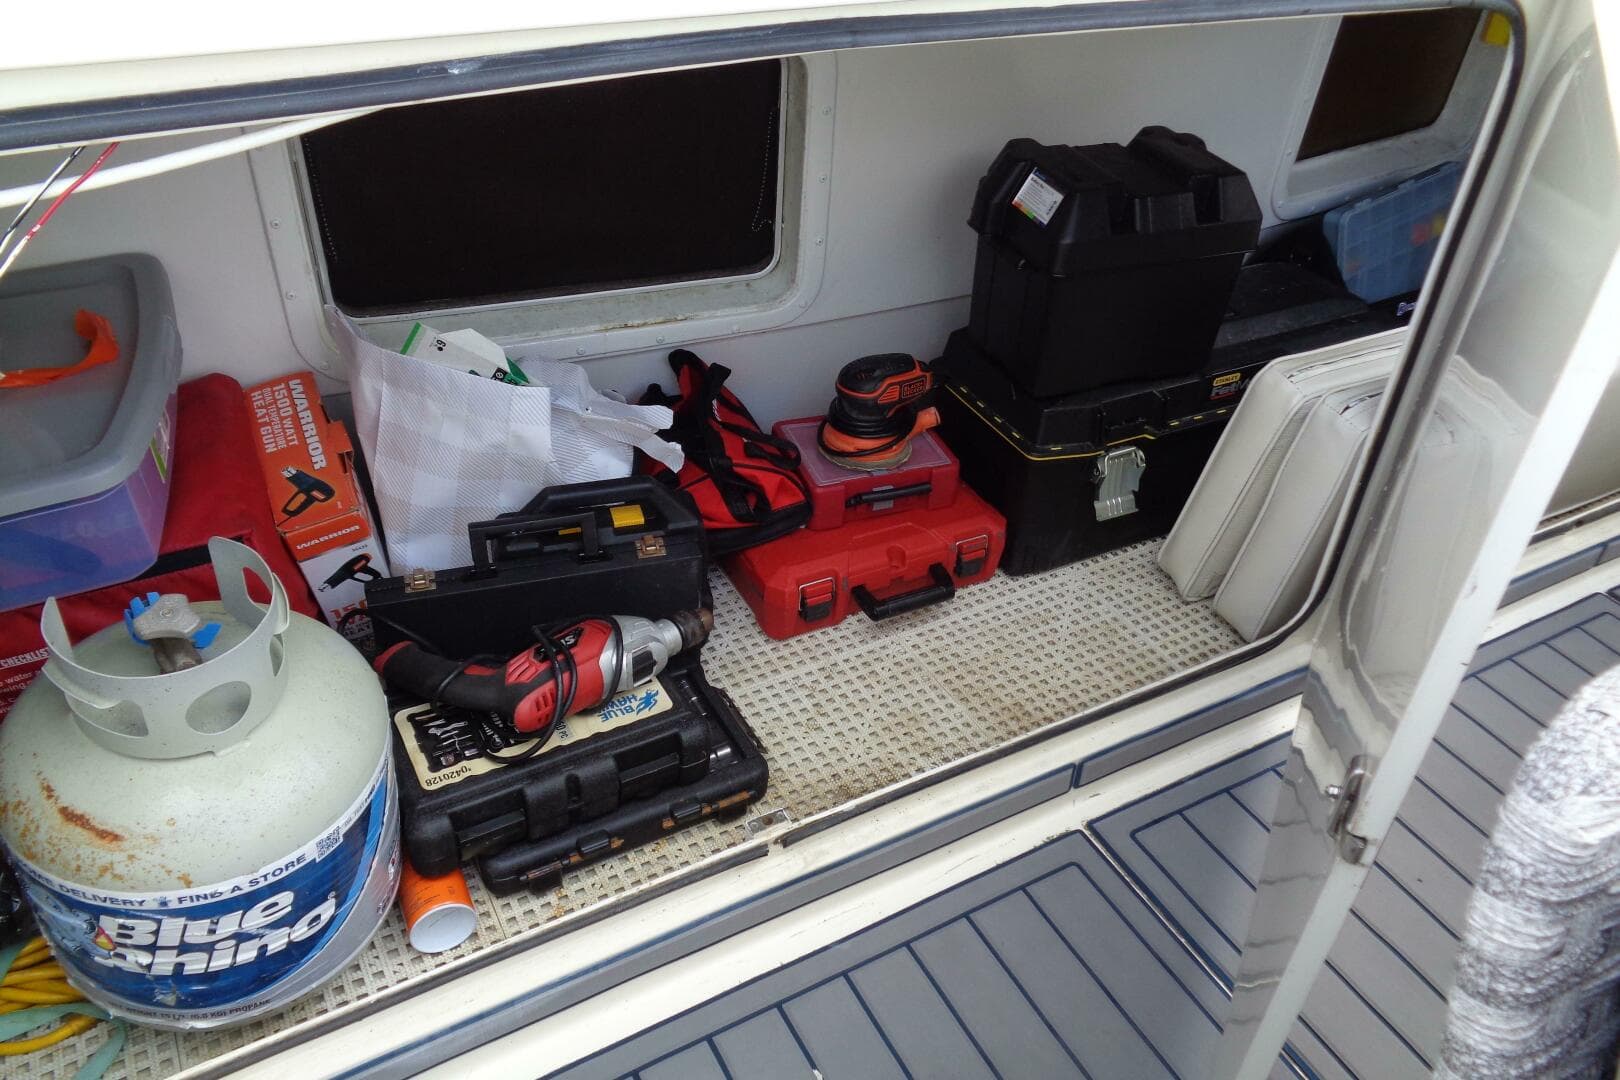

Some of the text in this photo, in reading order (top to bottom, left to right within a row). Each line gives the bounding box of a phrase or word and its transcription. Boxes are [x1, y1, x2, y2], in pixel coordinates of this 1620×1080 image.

[251, 390, 278, 454] HEAT GUN
[273, 382, 299, 446] 1500 WATT
[288, 379, 327, 471] WARRIOR
[296, 525, 361, 551] WARRIOR
[0, 646, 49, 668] CHECKLIS
[597, 705, 637, 724] BLUE
[59, 884, 147, 908] DELIVERY
[177, 893, 223, 905] FIND
[230, 884, 244, 895] A
[247, 852, 308, 888] STORE
[94, 896, 336, 976] Rhino
[99, 890, 295, 947] Blue
